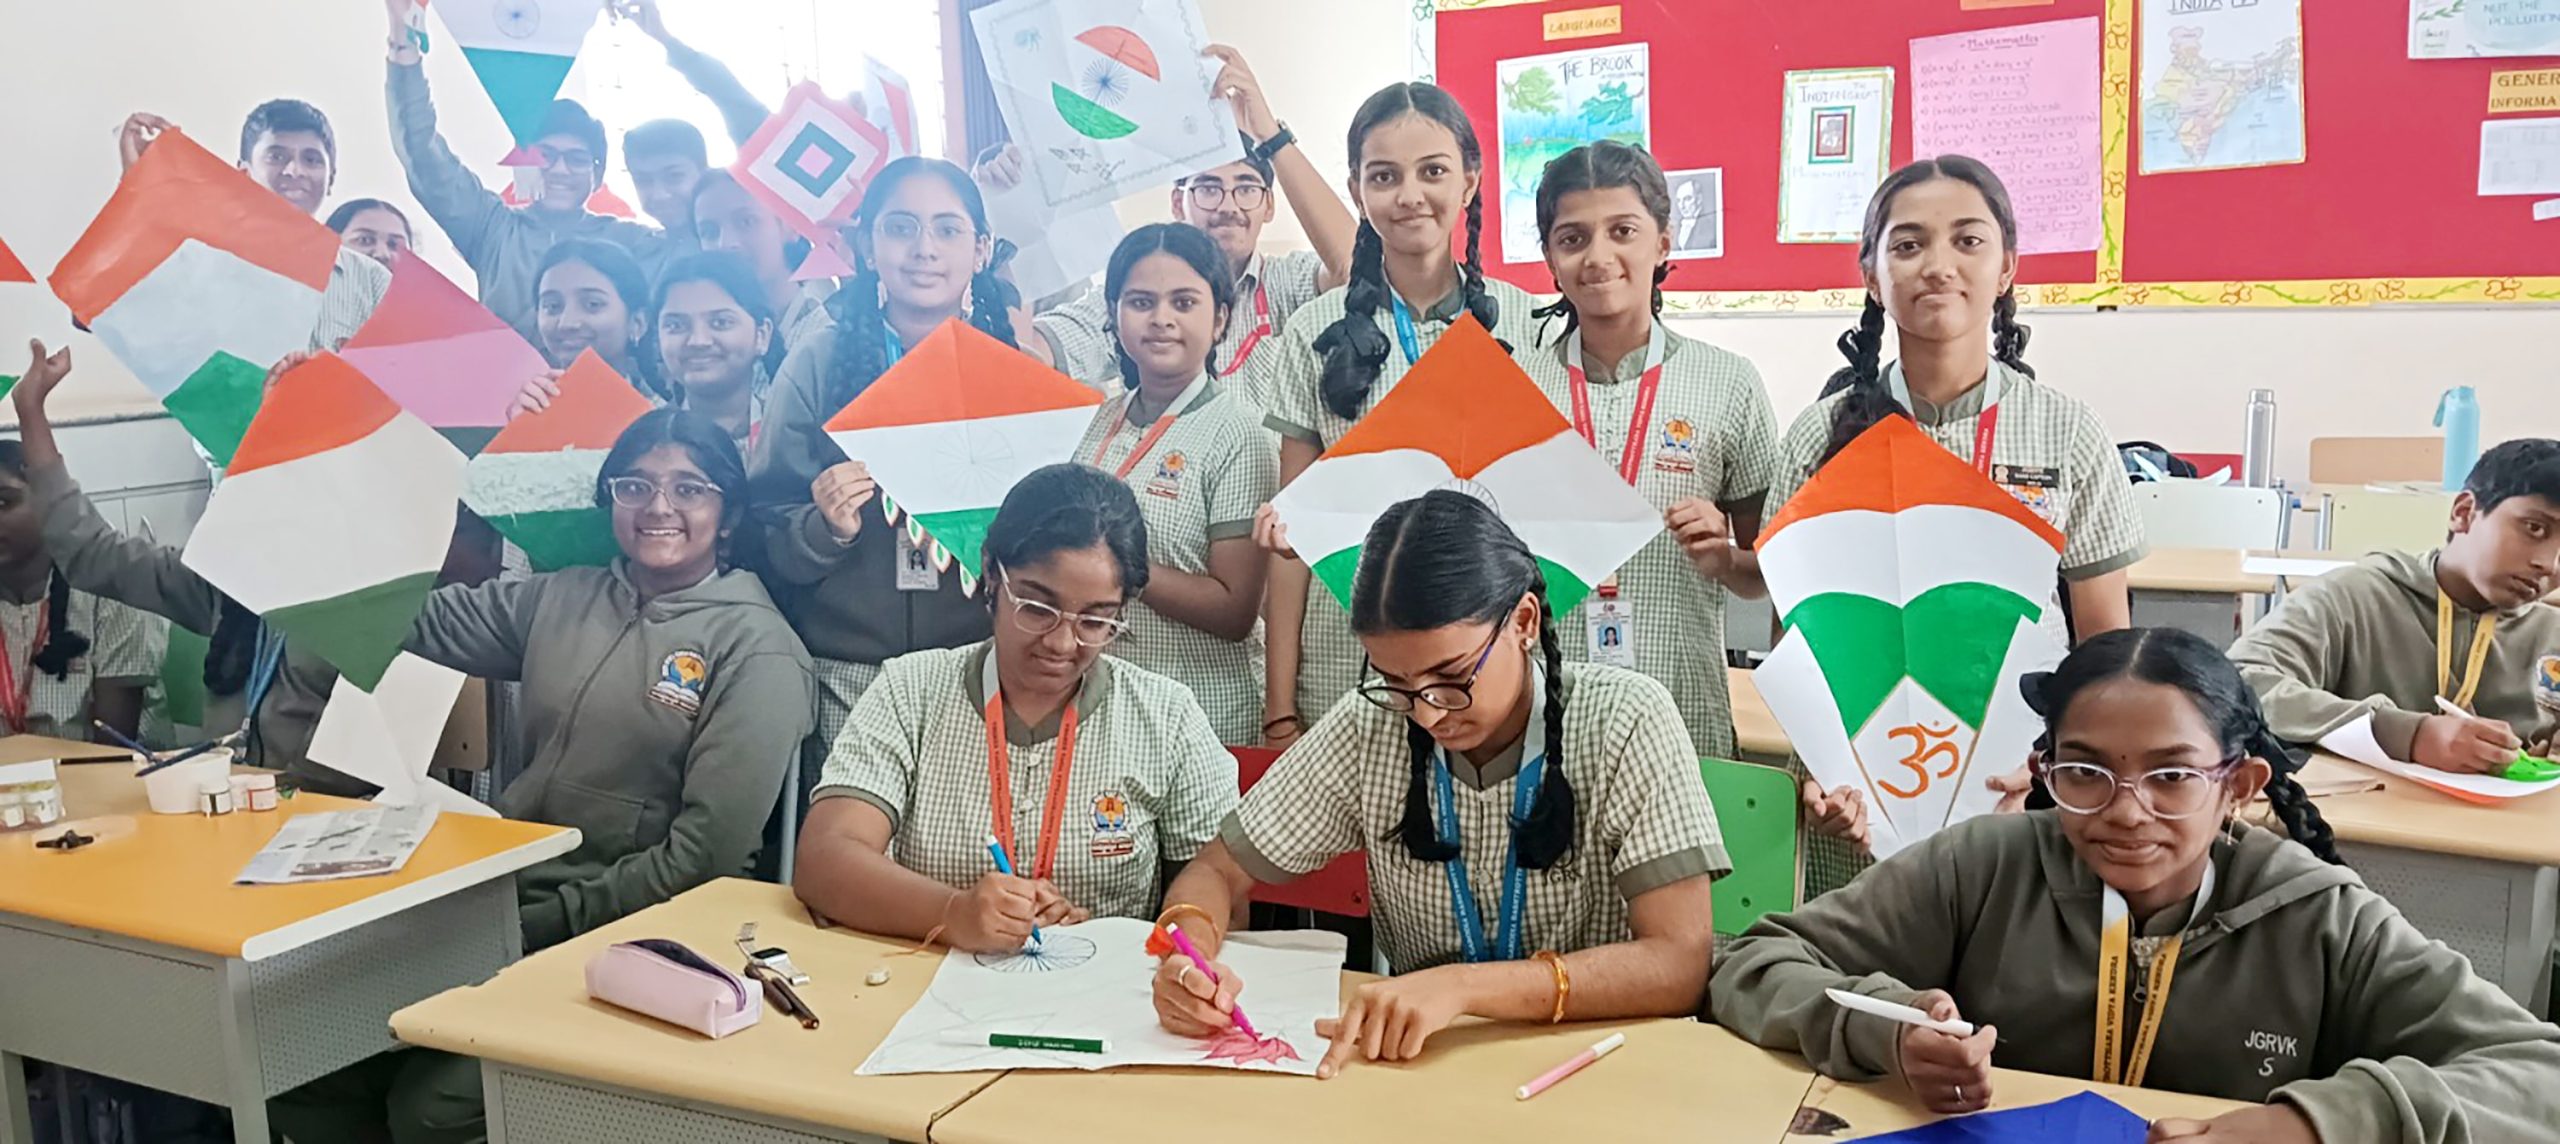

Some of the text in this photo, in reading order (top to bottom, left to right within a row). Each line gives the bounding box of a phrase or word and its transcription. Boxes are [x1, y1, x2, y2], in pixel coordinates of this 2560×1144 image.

[1548, 17, 1618, 33] LANGUAGES
[1558, 54, 1634, 85] THE BROOK
[2244, 1030, 2297, 1057] JGRVK
[2258, 1057, 2275, 1077] S
